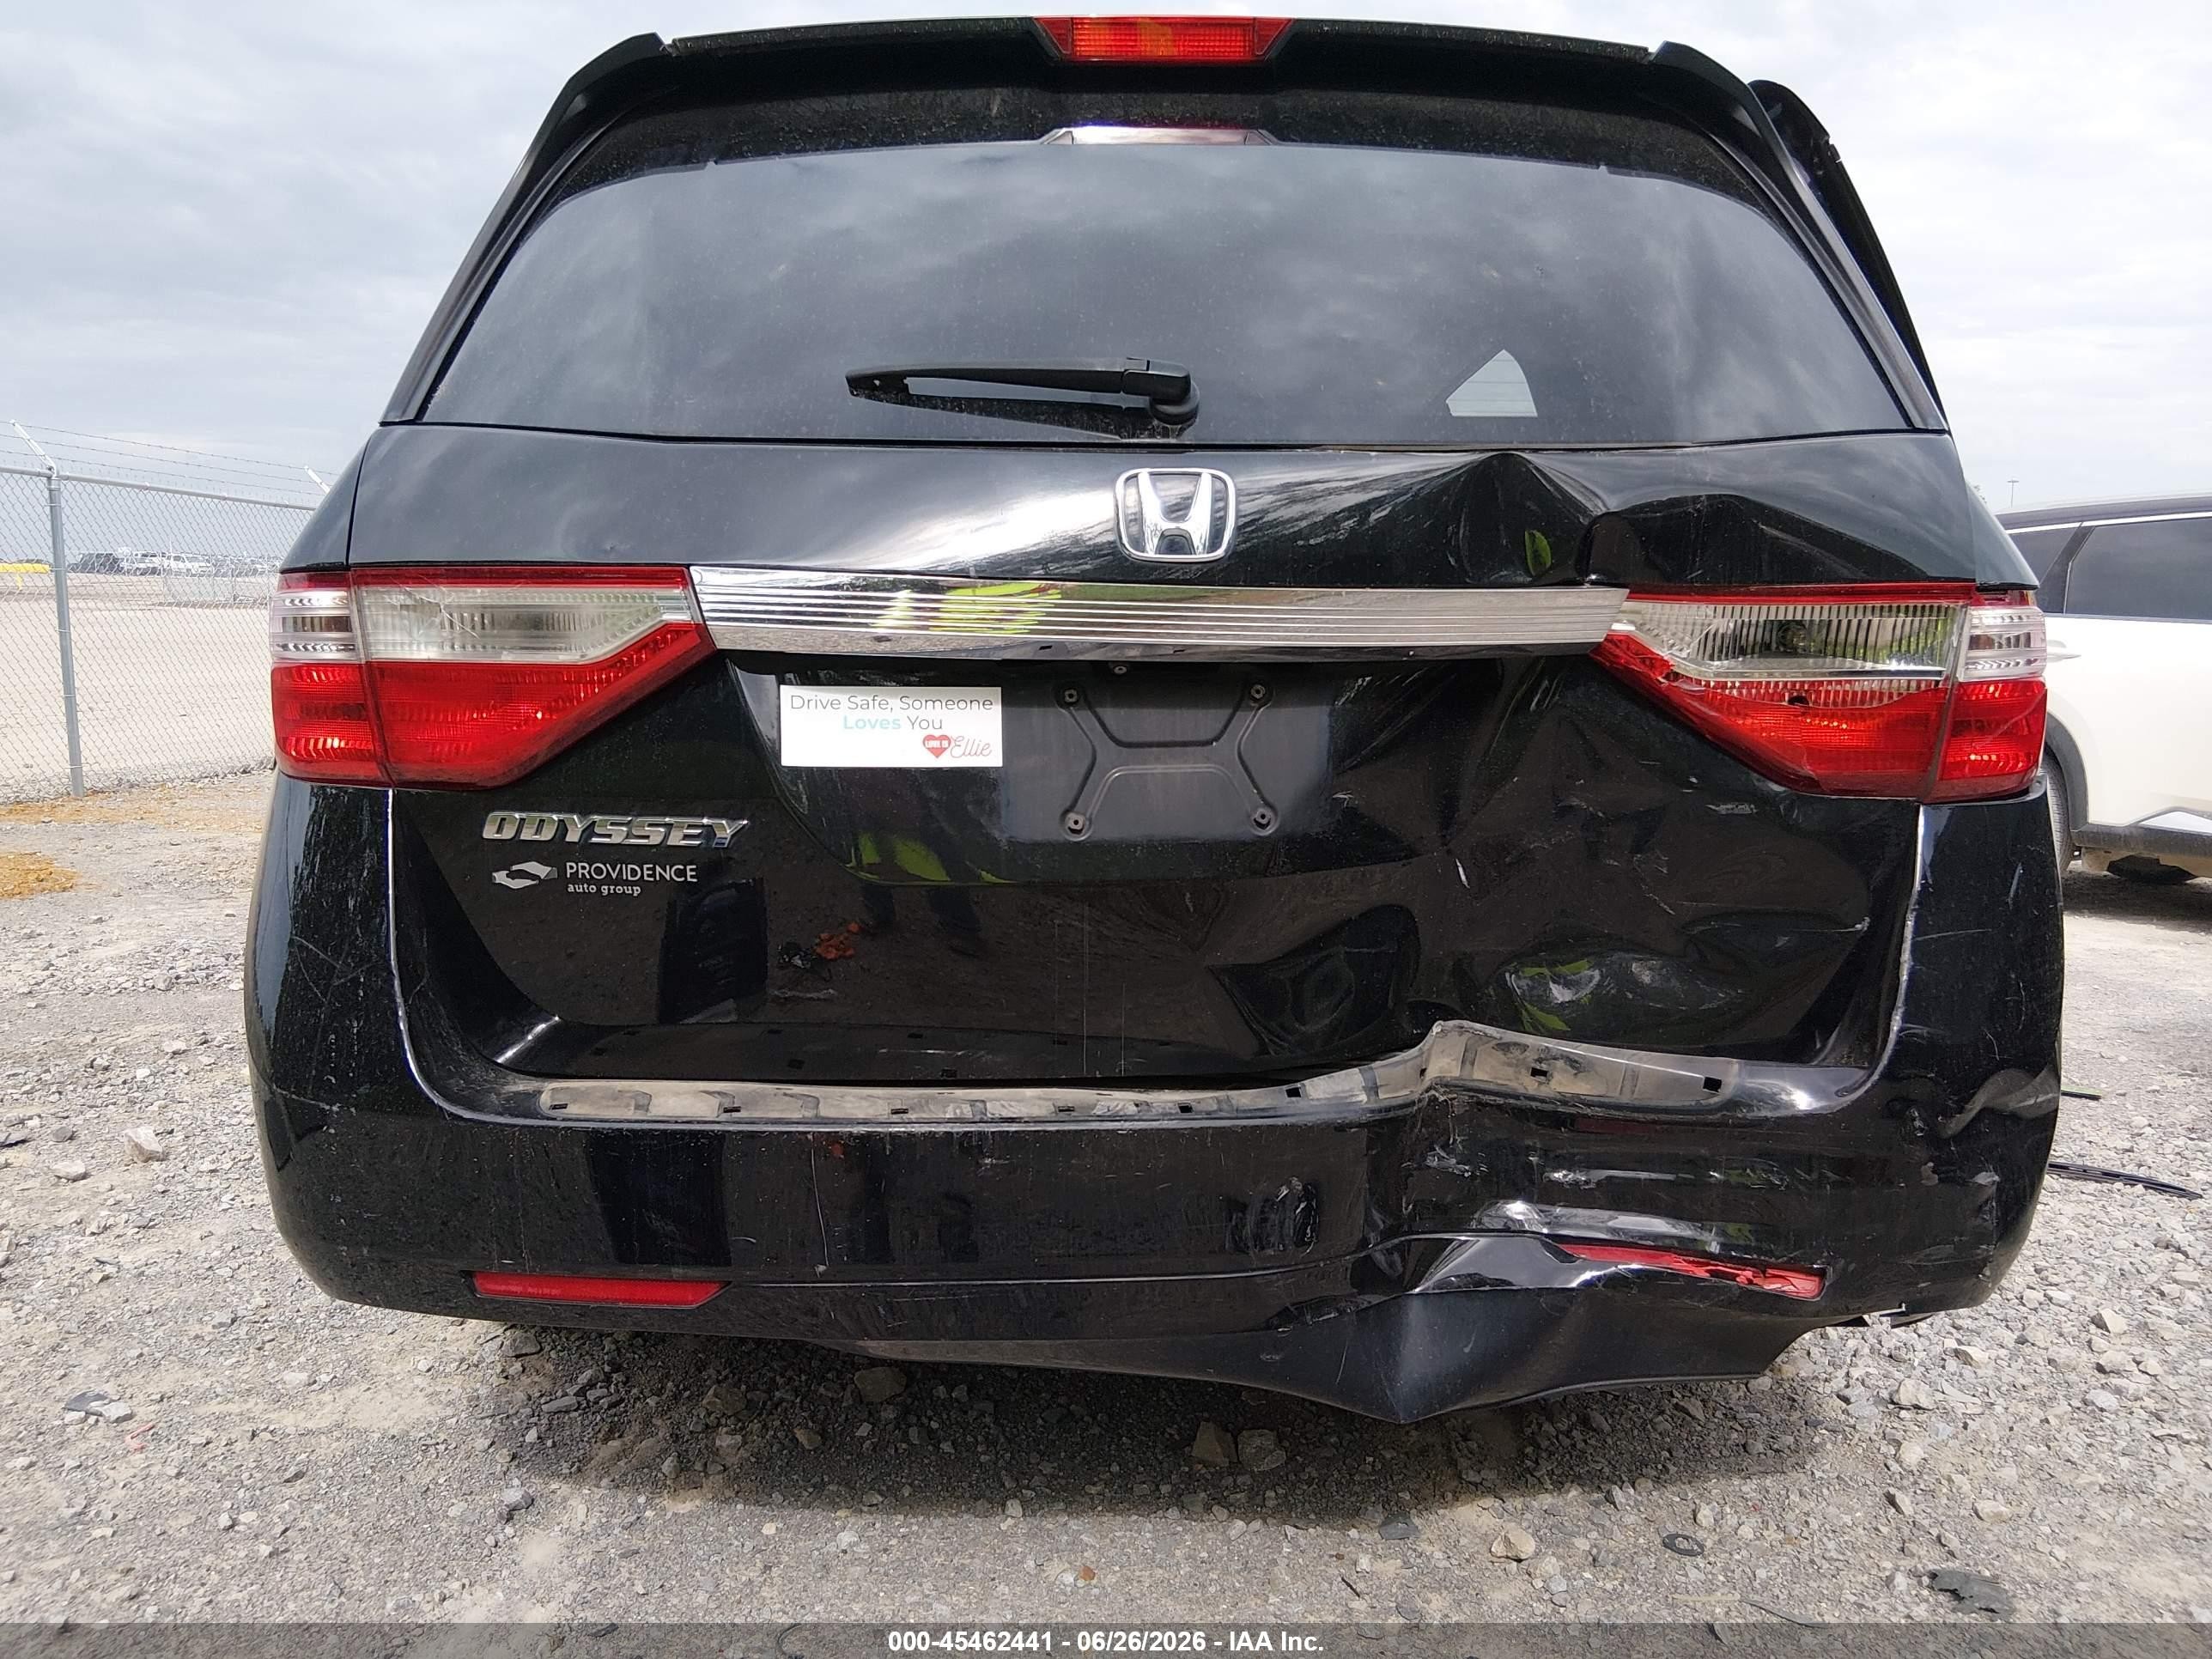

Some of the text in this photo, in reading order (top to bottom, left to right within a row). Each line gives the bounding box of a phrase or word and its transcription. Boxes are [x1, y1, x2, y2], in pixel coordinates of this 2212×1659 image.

[790, 695, 994, 713] Drive Safe, Someone
[843, 715, 944, 730] Loves You
[950, 735, 993, 759] Ellie
[482, 811, 750, 848] ODYSSEY
[565, 862, 698, 882] PROVIDENCE
[567, 883, 641, 896] auto group
